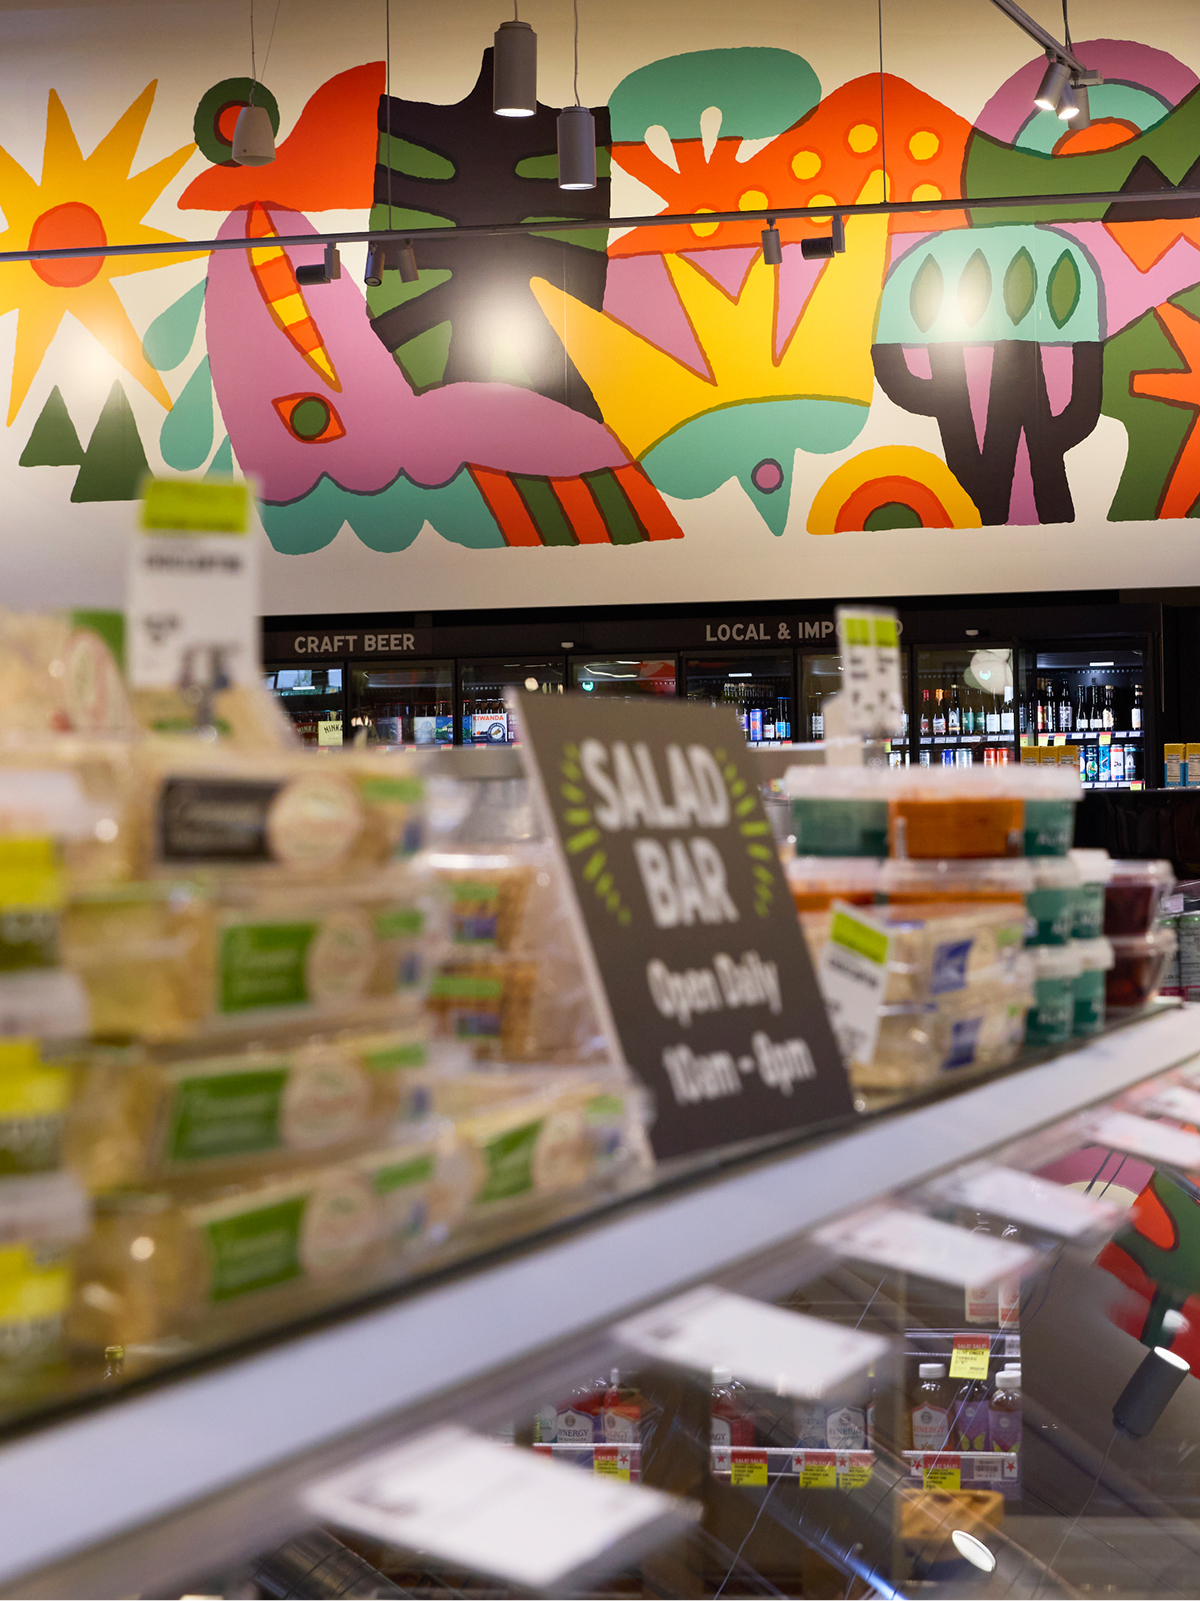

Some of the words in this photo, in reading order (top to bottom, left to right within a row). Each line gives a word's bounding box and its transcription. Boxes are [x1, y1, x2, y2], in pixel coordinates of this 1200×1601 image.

[705, 622, 771, 642] LOCAL
[777, 622, 791, 640] &
[294, 635, 358, 654] CRAFT
[364, 633, 415, 652] BEER
[297, 724, 319, 735] NINKA
[323, 723, 343, 734] NINKA
[580, 738, 731, 833] SALAD
[633, 836, 740, 928] BAR
[646, 957, 723, 1028] Open
[712, 950, 783, 1015] Daily
